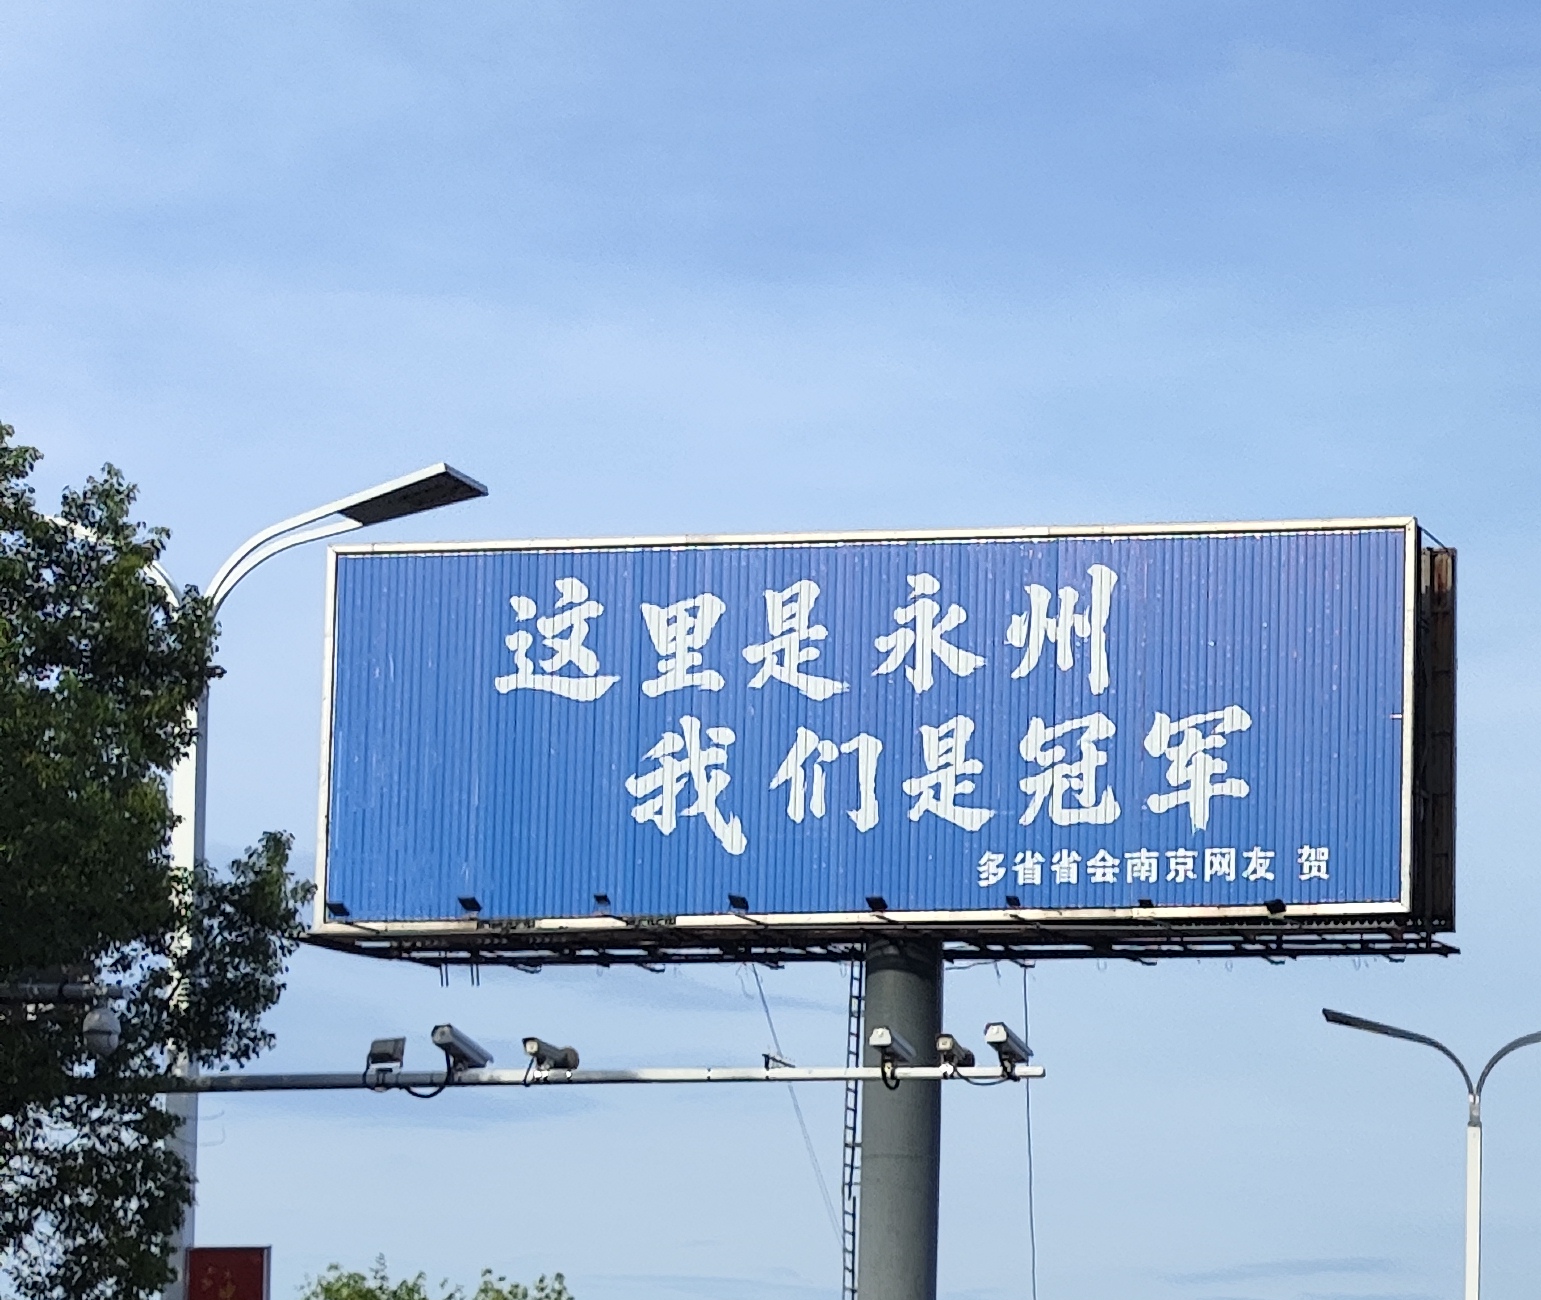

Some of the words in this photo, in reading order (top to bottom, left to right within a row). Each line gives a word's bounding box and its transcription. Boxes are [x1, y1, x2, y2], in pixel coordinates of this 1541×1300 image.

[494, 563, 1118, 702] 这里是永州
[624, 703, 1253, 856] 我们是冠军
[977, 847, 1276, 887] 多省省会南京网友
[1297, 845, 1331, 881] 贺
